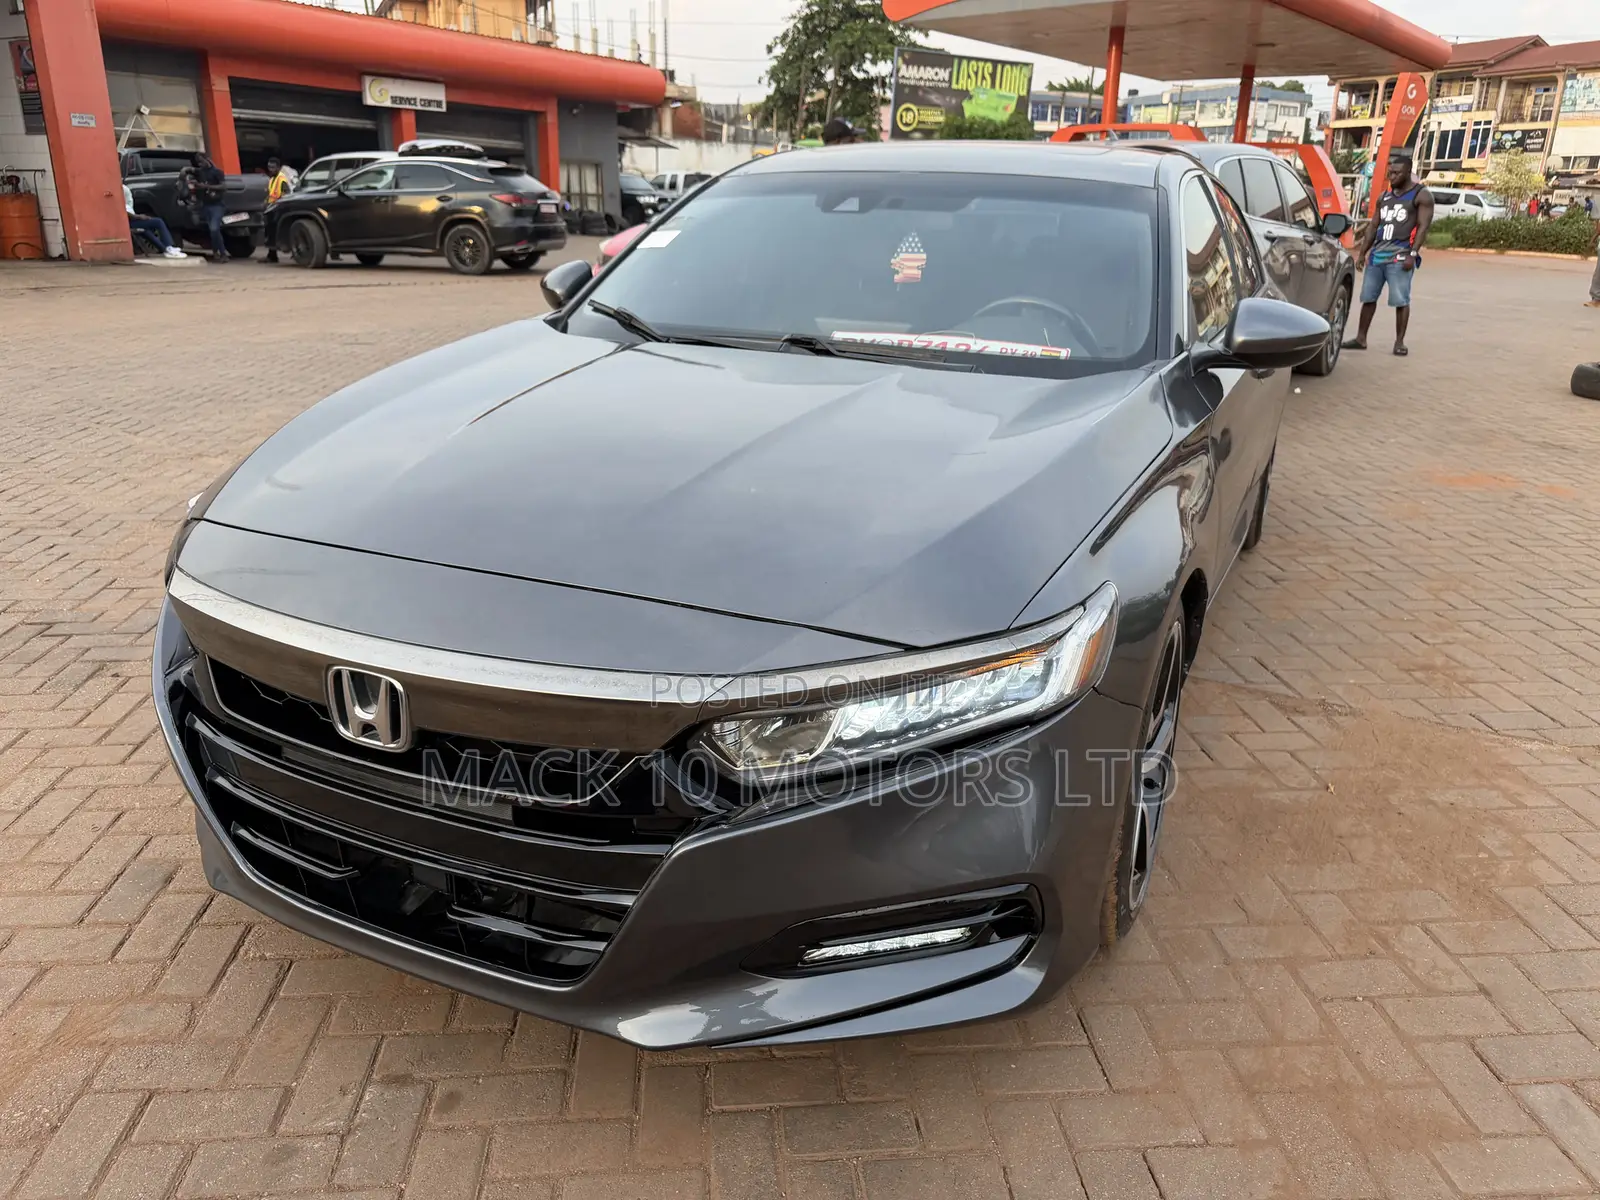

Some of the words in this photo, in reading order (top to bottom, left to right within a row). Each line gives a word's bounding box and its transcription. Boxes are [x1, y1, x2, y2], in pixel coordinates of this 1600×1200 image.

[898, 64, 949, 81] AMARON
[952, 58, 992, 91] LASTS
[995, 64, 1031, 96] LONG
[390, 95, 417, 106] SERVICE
[419, 98, 443, 109] CENTRE
[902, 110, 914, 124] 18
[1382, 223, 1394, 240] 10
